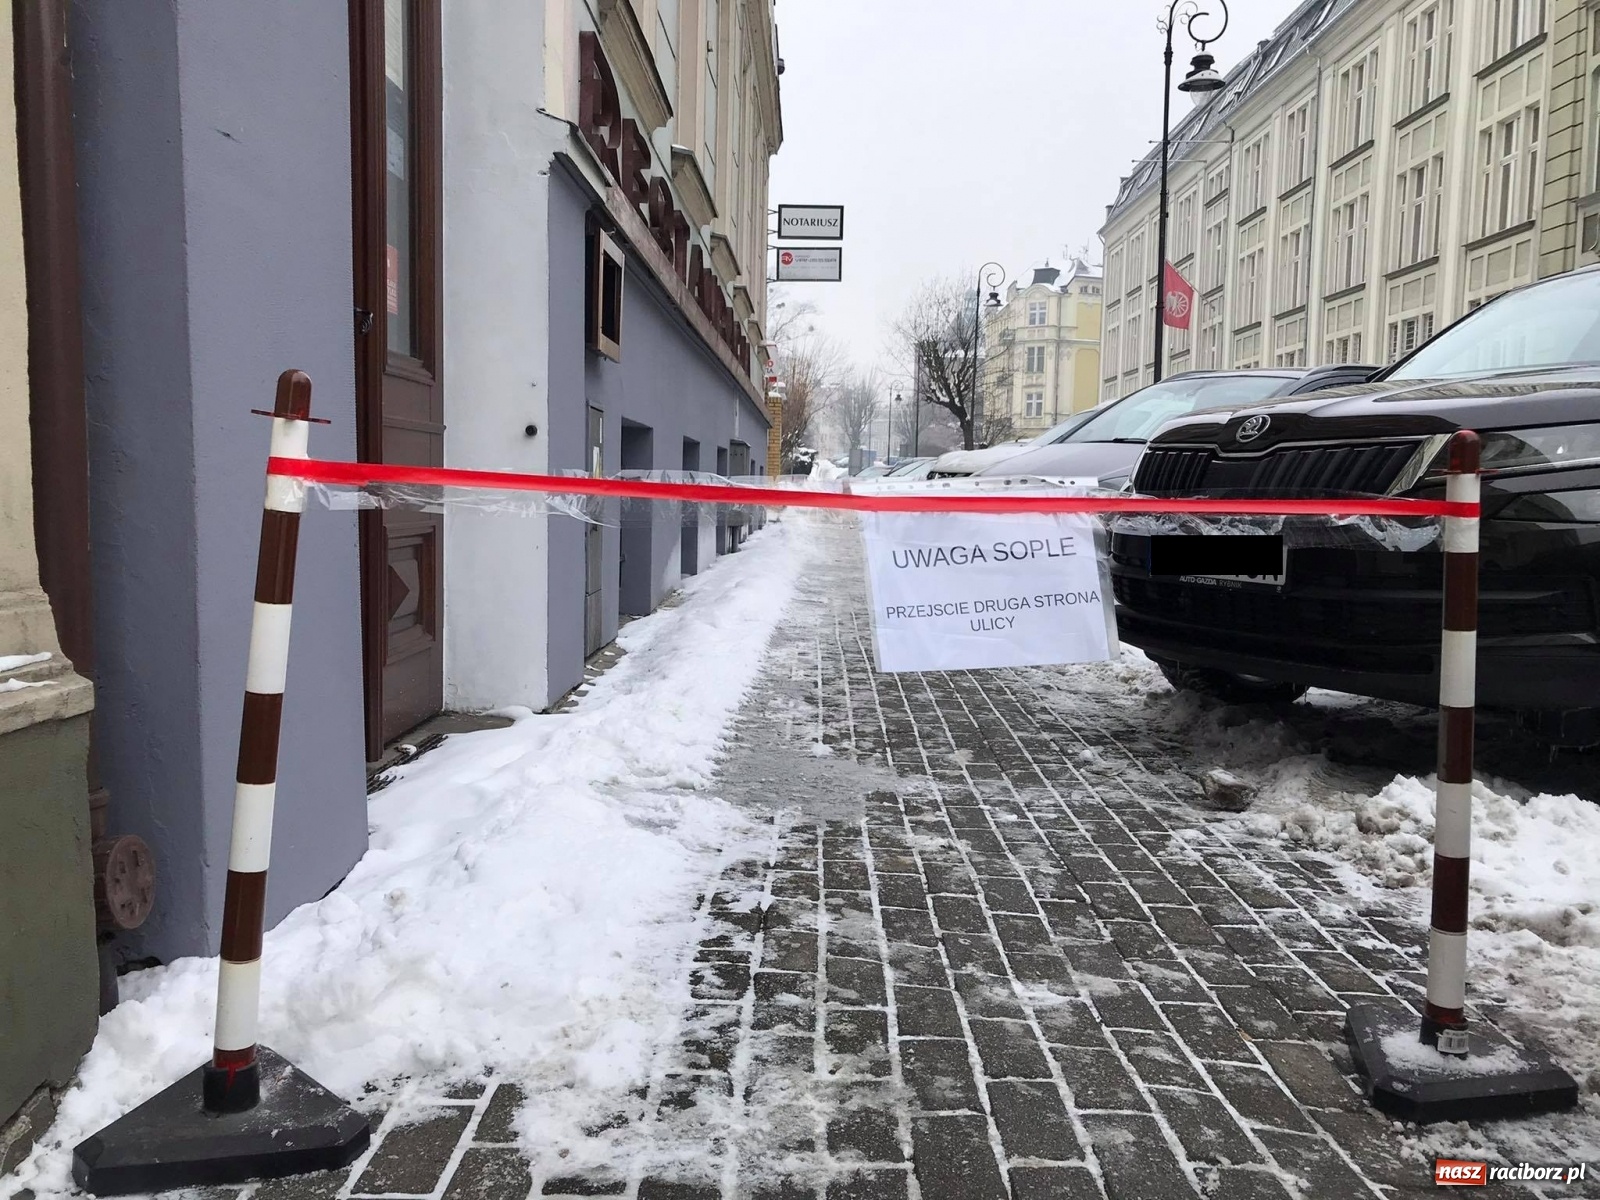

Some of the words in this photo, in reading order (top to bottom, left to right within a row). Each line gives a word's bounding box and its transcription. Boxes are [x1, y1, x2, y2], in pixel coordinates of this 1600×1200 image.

[782, 217, 838, 227] NOTARIUSZ
[893, 544, 987, 569] UWAGA
[993, 536, 1077, 562] SOPLE
[886, 602, 969, 618] PRZEJSCIE
[974, 597, 1031, 613] DRUGA
[1034, 590, 1100, 607] STRONA
[970, 616, 1015, 632] ULICY
